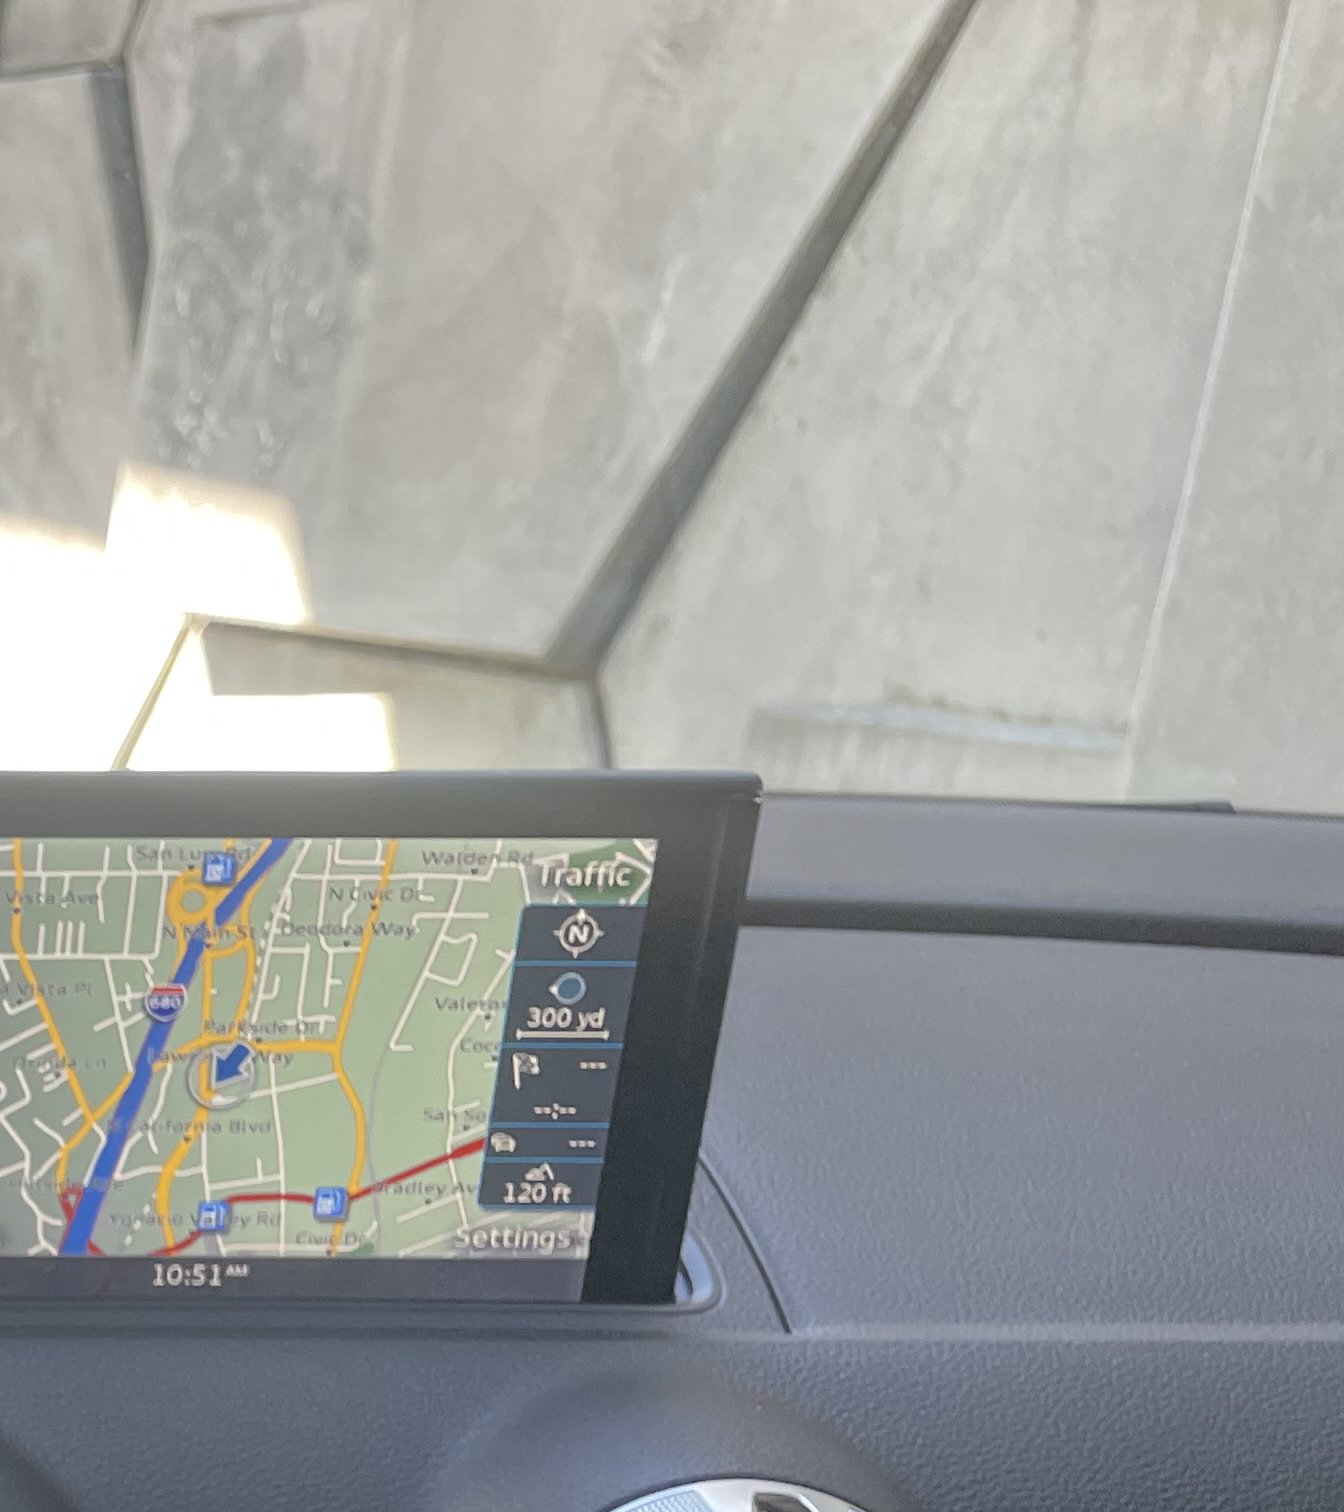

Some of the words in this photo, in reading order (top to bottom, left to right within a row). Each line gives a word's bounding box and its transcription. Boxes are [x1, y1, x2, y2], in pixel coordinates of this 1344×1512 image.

[421, 851, 499, 866] Walden
[537, 860, 632, 888] Traffic
[370, 922, 417, 942] Way
[526, 1006, 572, 1029] 300
[576, 1007, 607, 1033] yd
[228, 1118, 272, 1135] Blvd
[371, 1180, 445, 1200] Bradley
[503, 1182, 547, 1204] 120
[551, 1182, 573, 1204] ft
[455, 1225, 572, 1254] Settings
[152, 1262, 222, 1288] 10:51
[224, 1263, 250, 1278] AM
